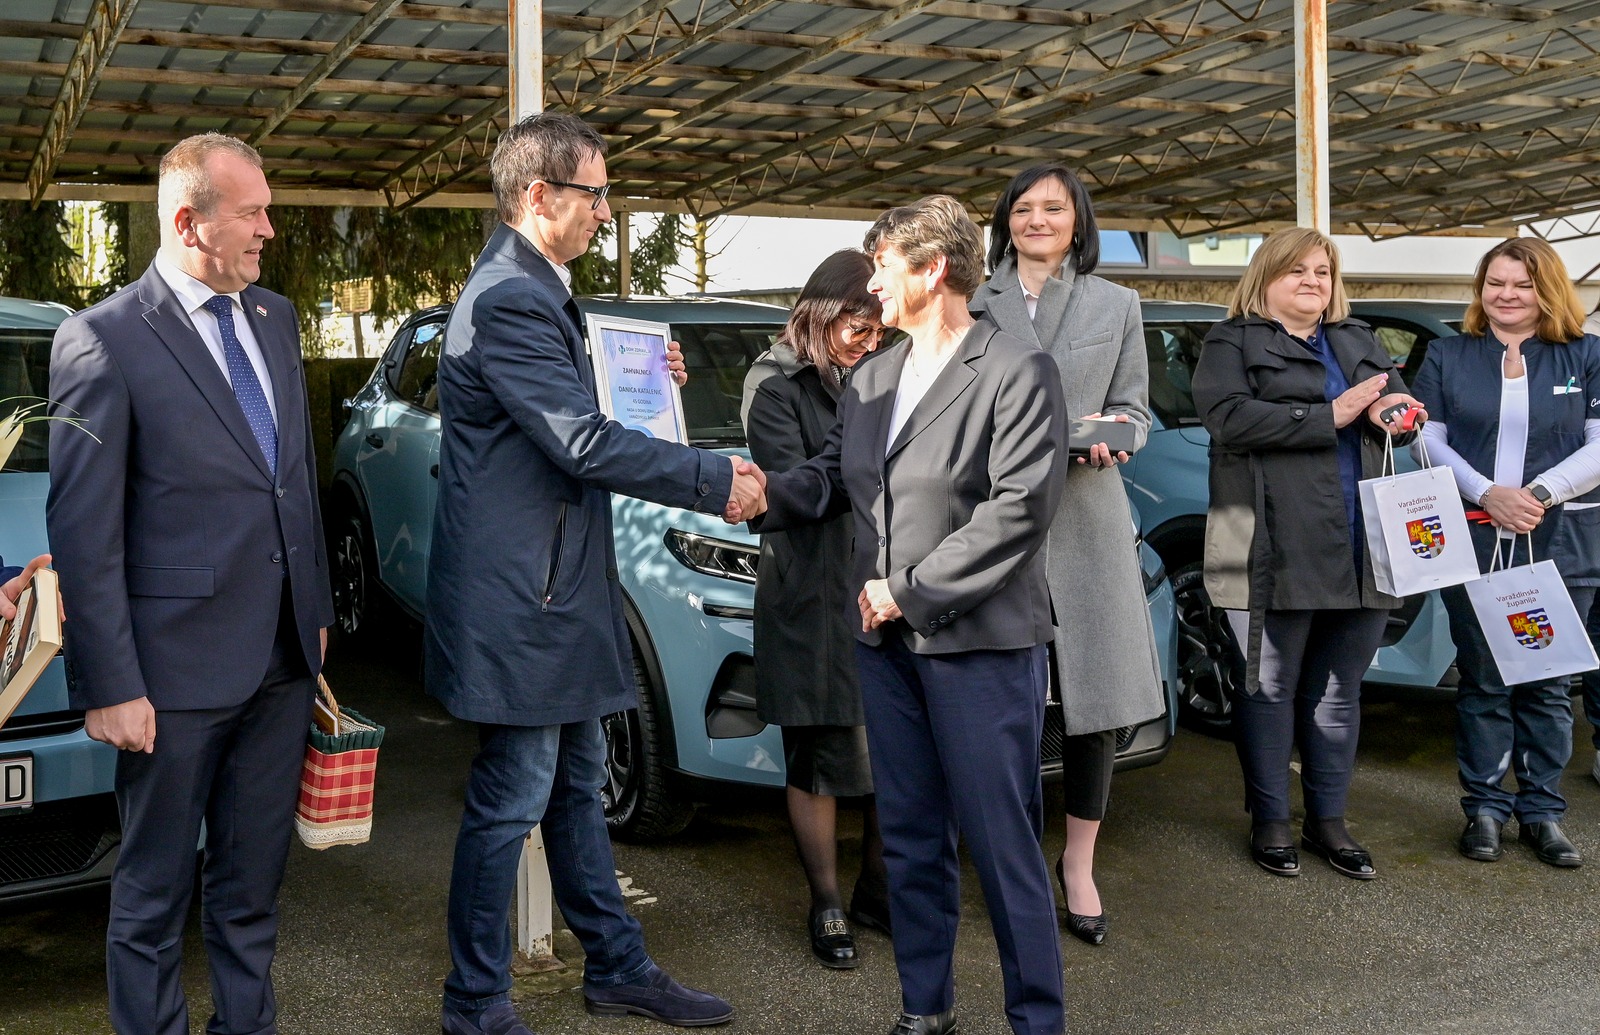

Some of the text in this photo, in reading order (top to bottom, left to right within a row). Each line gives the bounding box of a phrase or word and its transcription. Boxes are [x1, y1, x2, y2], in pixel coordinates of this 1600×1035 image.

[623, 367, 652, 376] ZAHVALNICA
[1398, 495, 1437, 509] Varaždinska
[1407, 504, 1434, 515] županija
[1496, 588, 1540, 603] Varaždinska
[1507, 597, 1537, 608] županija
